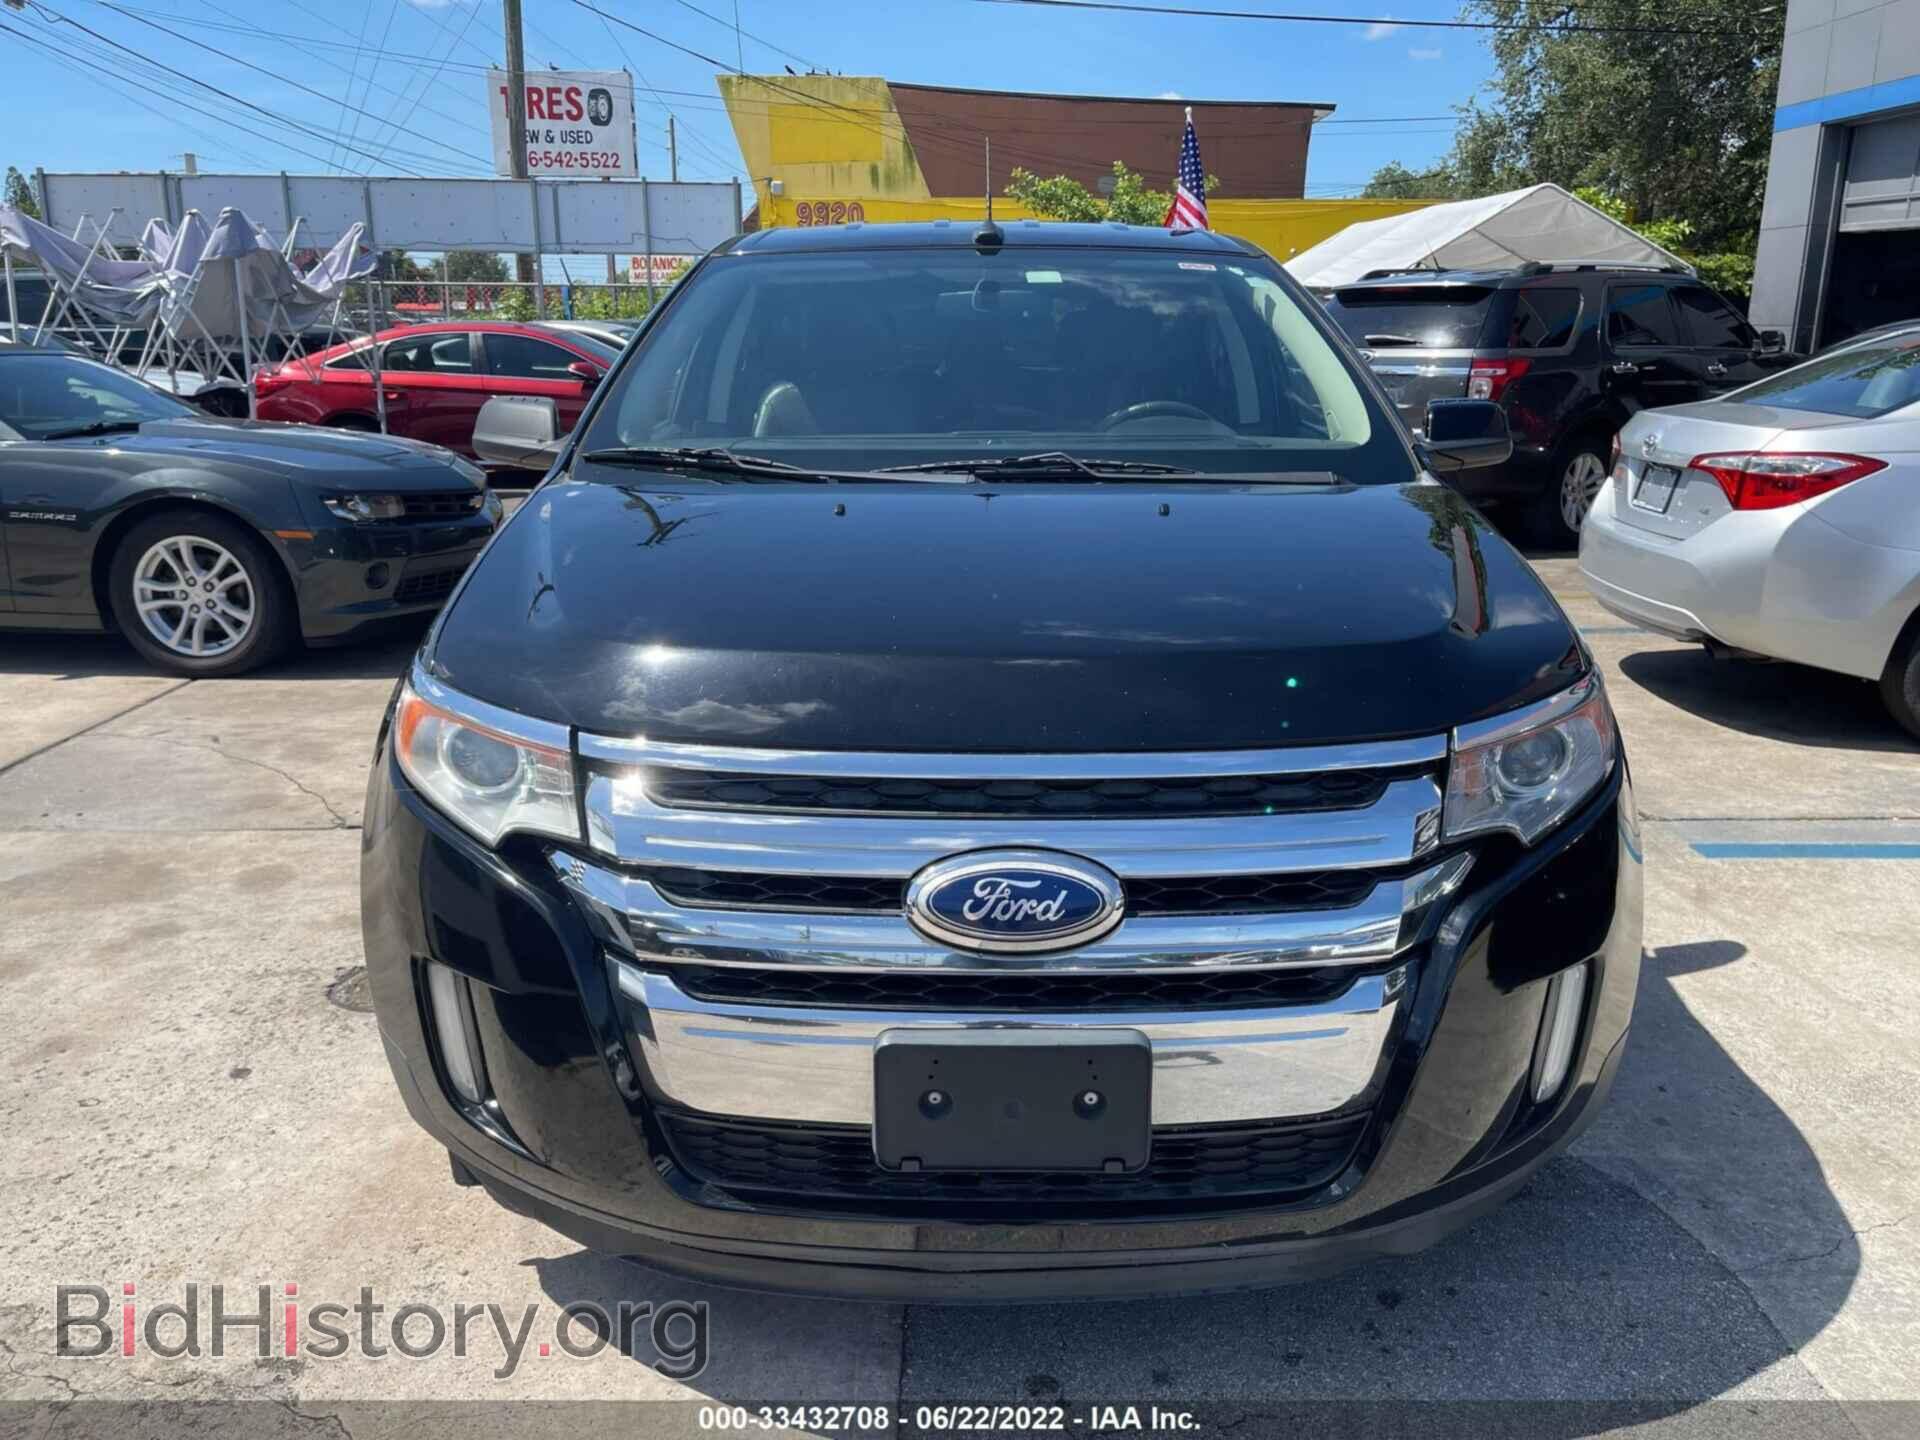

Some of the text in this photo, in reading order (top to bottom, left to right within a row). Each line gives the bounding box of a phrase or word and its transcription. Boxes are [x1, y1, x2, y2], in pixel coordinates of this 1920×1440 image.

[500, 86, 584, 121] TRES
[524, 129, 593, 144] EW & USED
[796, 201, 864, 226] 9920
[962, 876, 1068, 922] Ford
